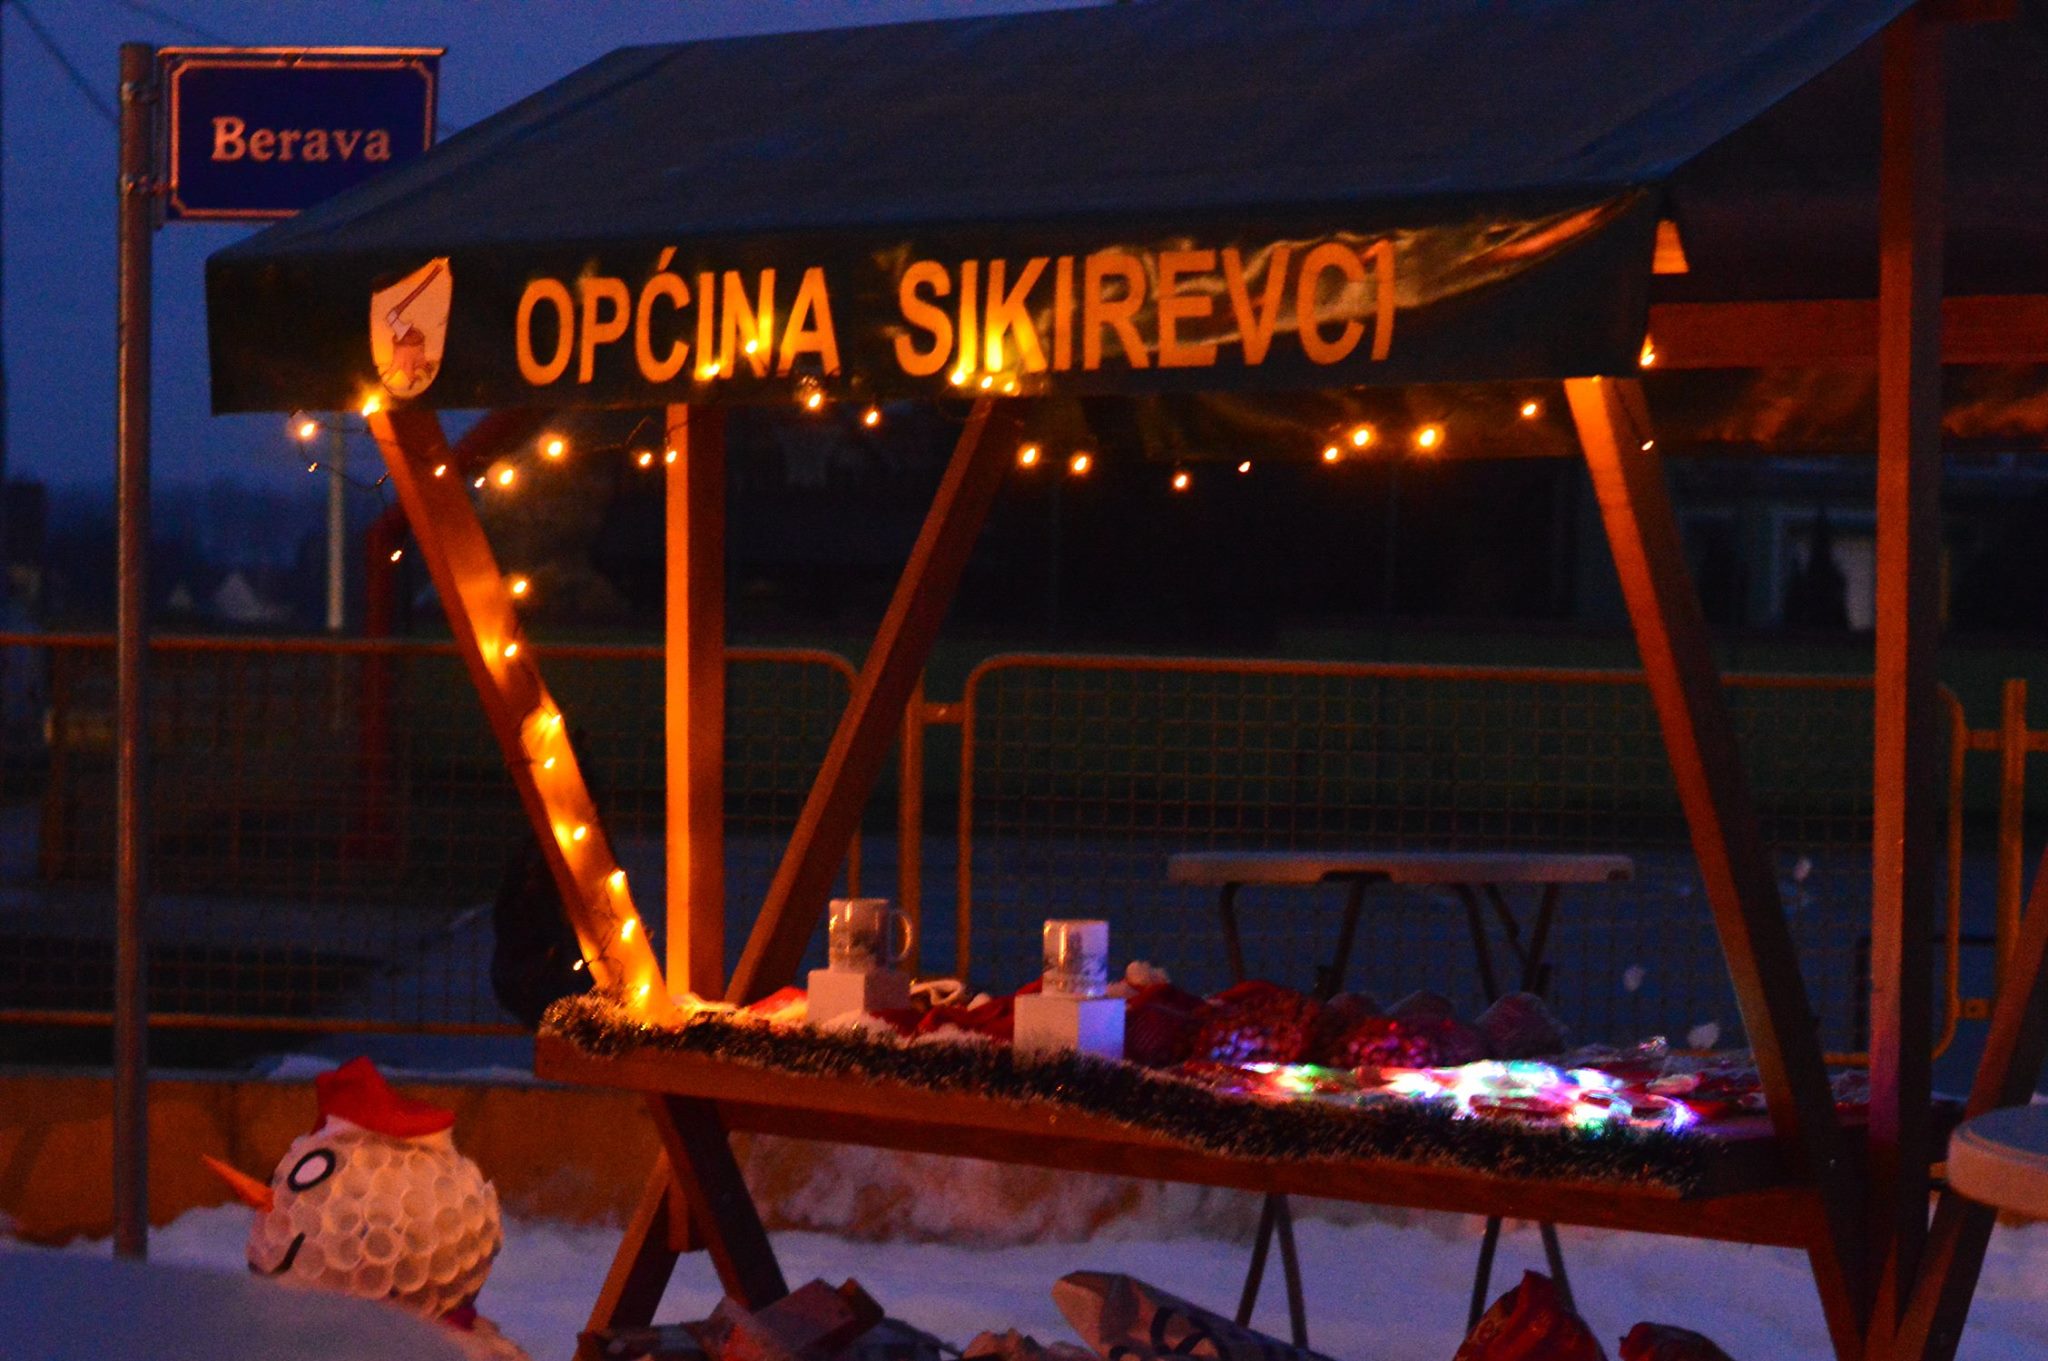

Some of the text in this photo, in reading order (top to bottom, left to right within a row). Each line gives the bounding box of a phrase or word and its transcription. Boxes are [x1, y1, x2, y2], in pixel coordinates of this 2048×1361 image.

[211, 116, 391, 162] Berava
[515, 239, 1395, 386] OPĆINA SIKIREVCI
